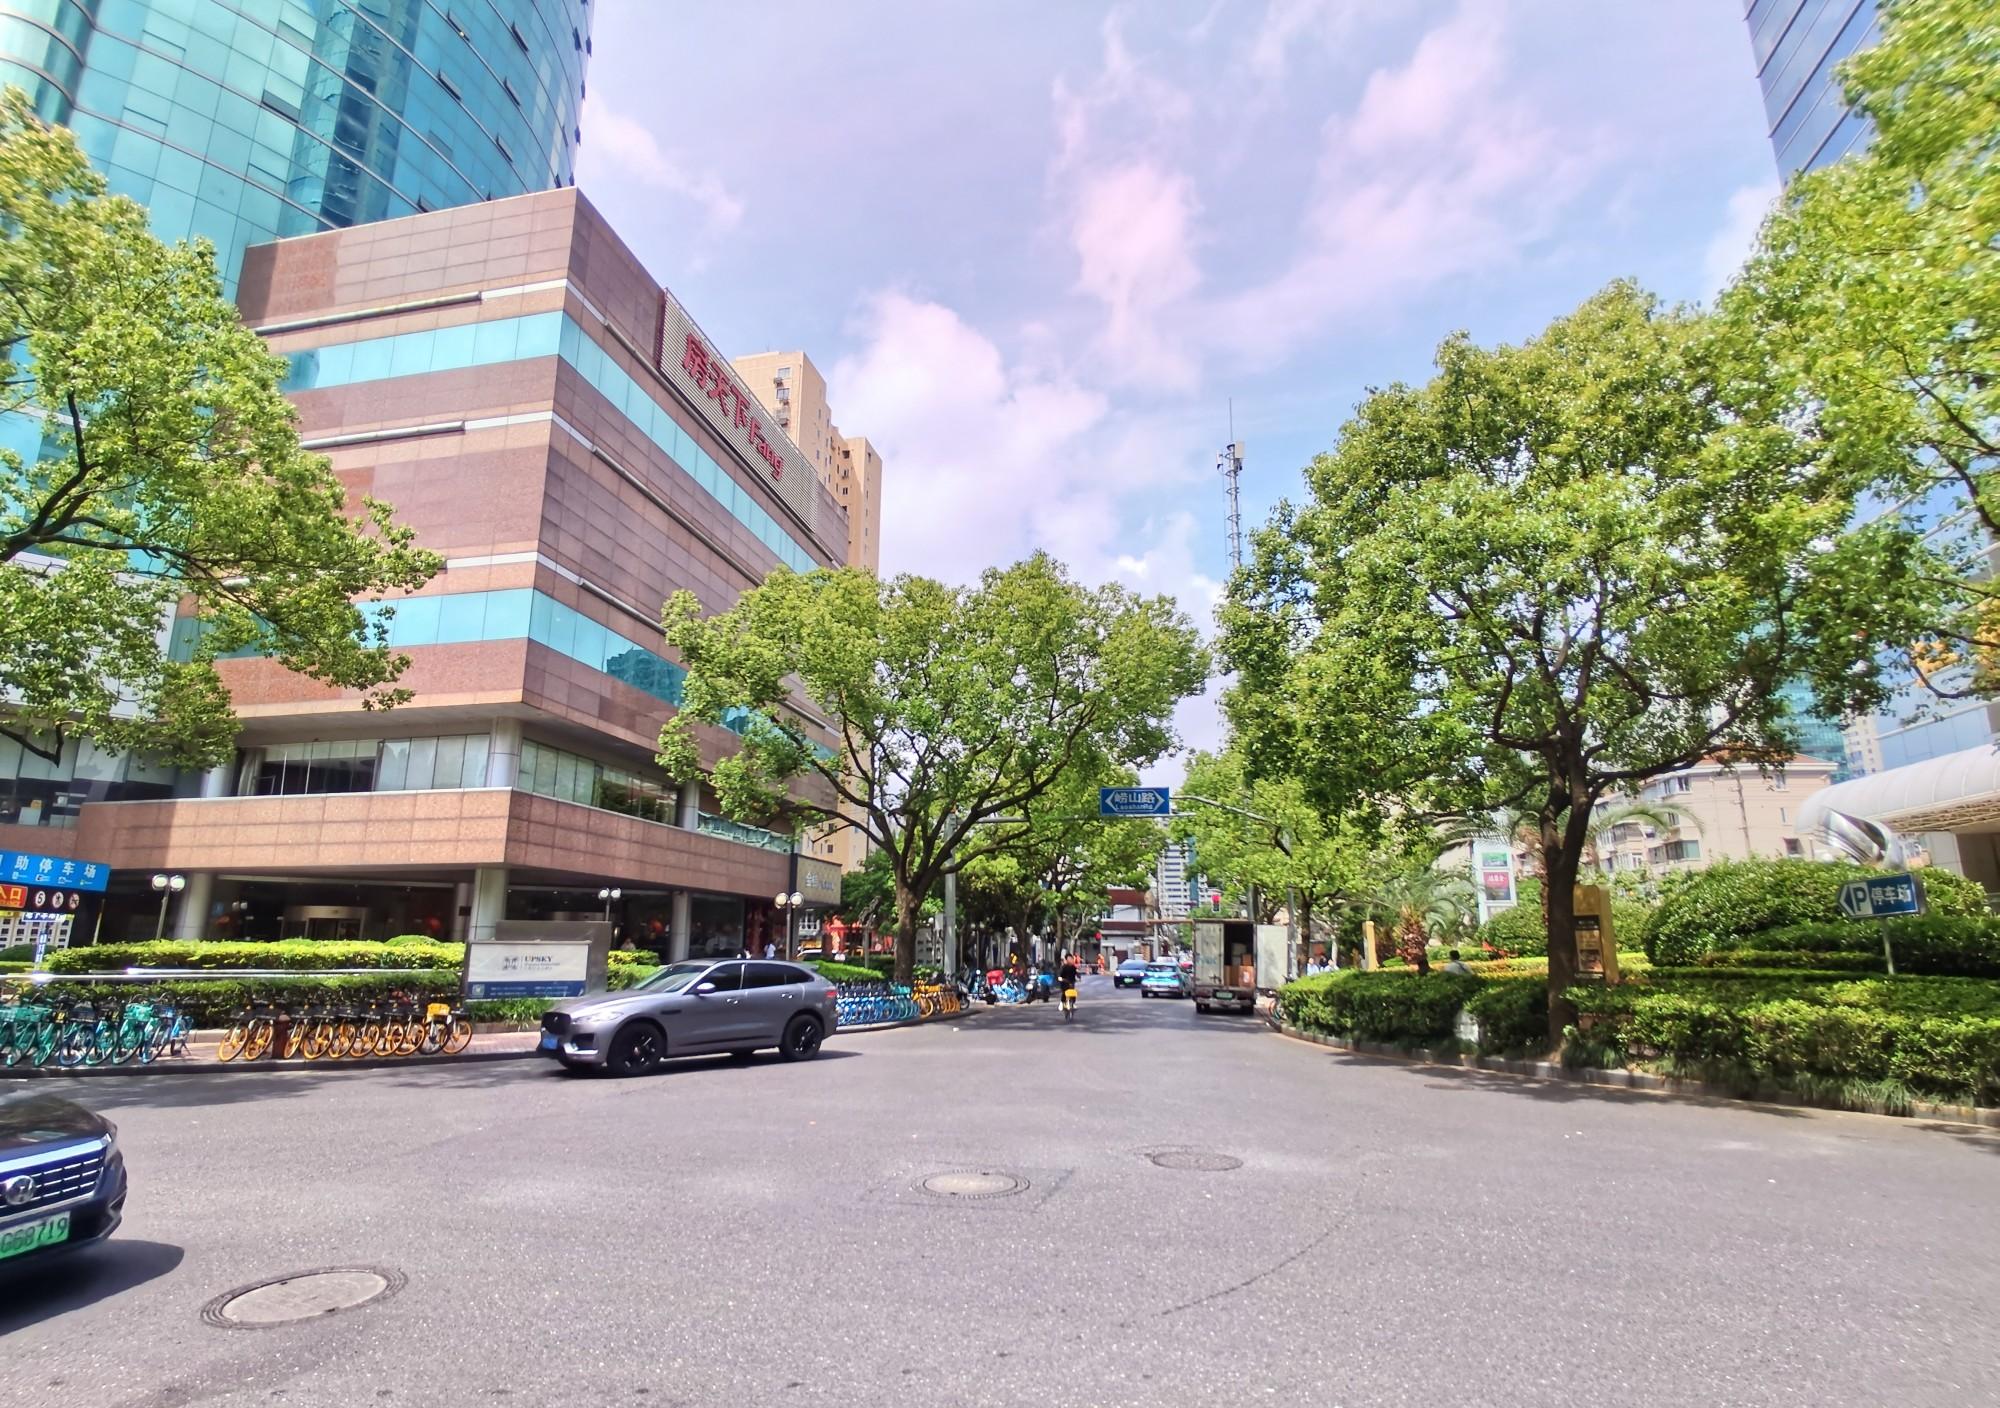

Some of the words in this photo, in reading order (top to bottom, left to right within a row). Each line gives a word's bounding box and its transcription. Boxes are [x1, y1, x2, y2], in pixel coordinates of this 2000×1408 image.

[682, 332, 750, 429] 房天下
[748, 416, 785, 482] Fang
[1114, 792, 1155, 803] 崂山路
[1853, 887, 1867, 912] P
